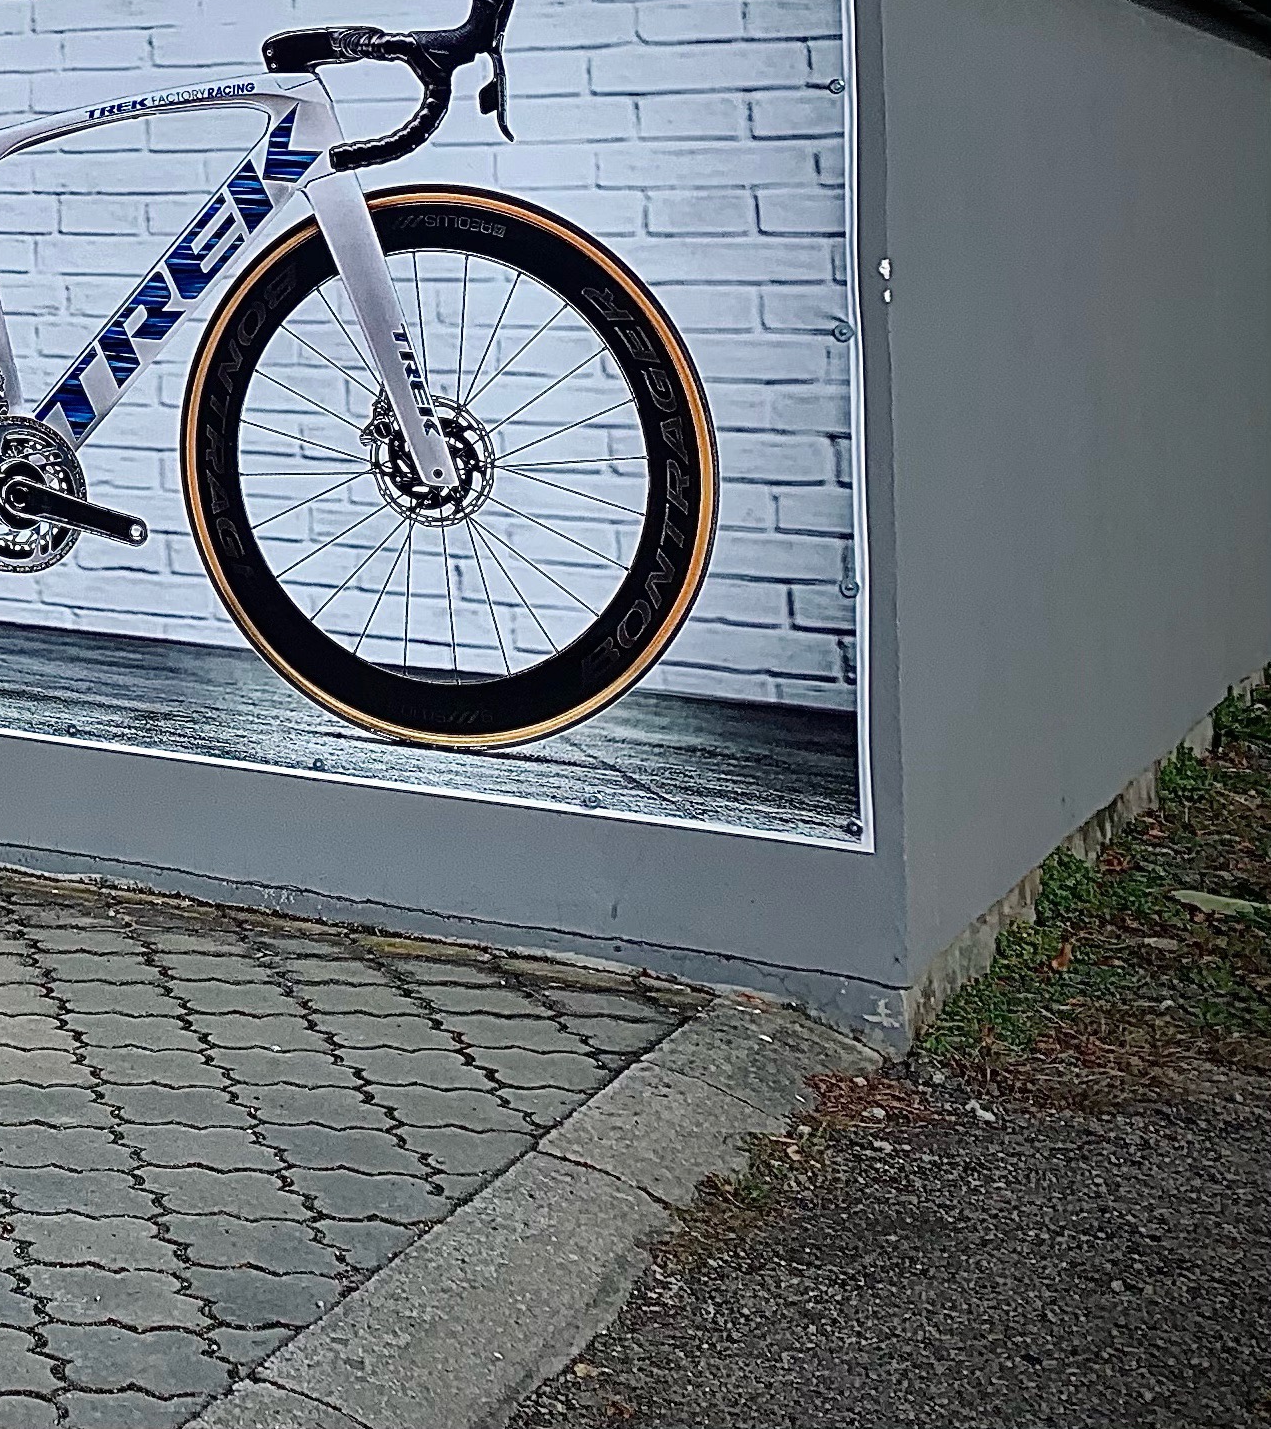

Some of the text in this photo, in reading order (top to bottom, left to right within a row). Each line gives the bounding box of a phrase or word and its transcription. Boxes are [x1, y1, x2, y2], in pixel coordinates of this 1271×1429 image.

[85, 97, 148, 120] TREK
[35, 101, 324, 442] TREK
[205, 260, 297, 577] BONTRAG
[392, 323, 442, 437] TREK
[581, 286, 690, 686] BONTRAGER
